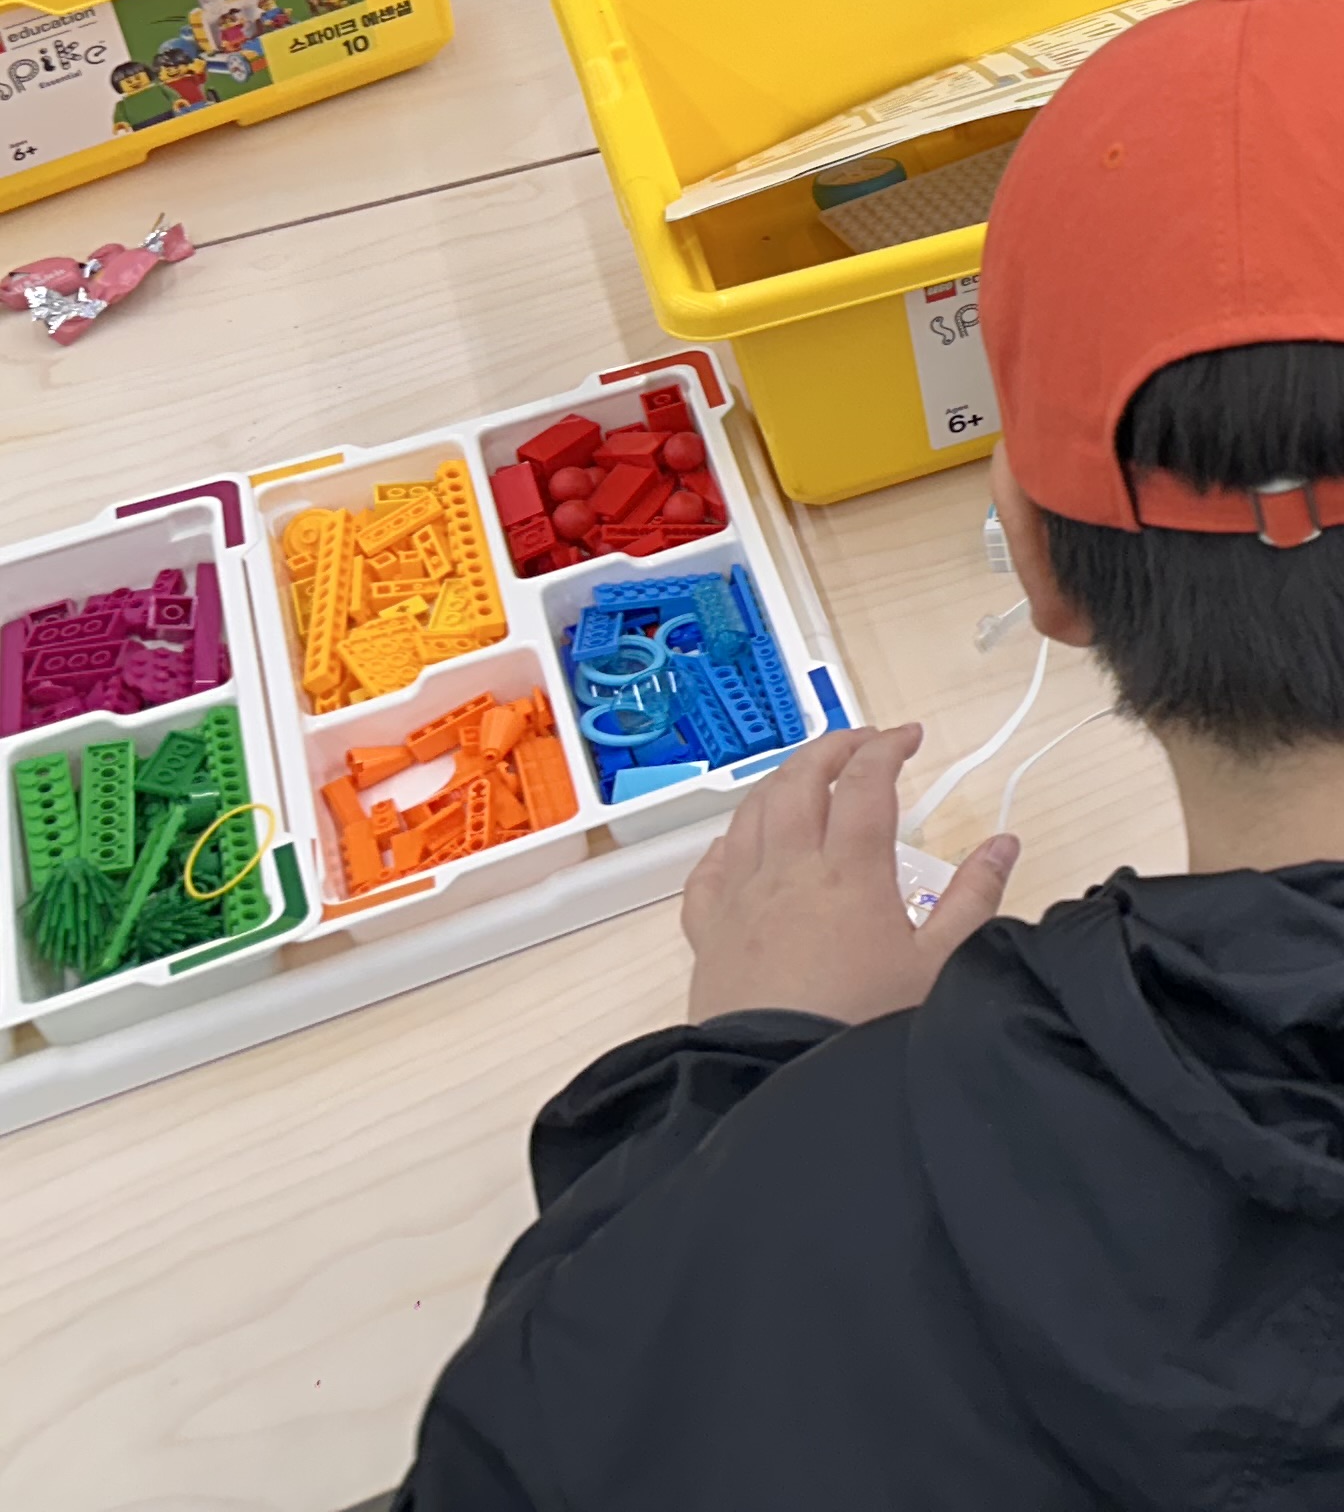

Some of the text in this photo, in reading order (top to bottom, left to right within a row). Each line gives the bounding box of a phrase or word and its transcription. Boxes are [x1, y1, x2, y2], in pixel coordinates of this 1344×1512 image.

[7, 7, 97, 43] education
[289, 0, 414, 54] 스파이크 에센셜
[342, 34, 370, 56] 10
[13, 145, 38, 162] 6+
[948, 413, 984, 434] 6+
